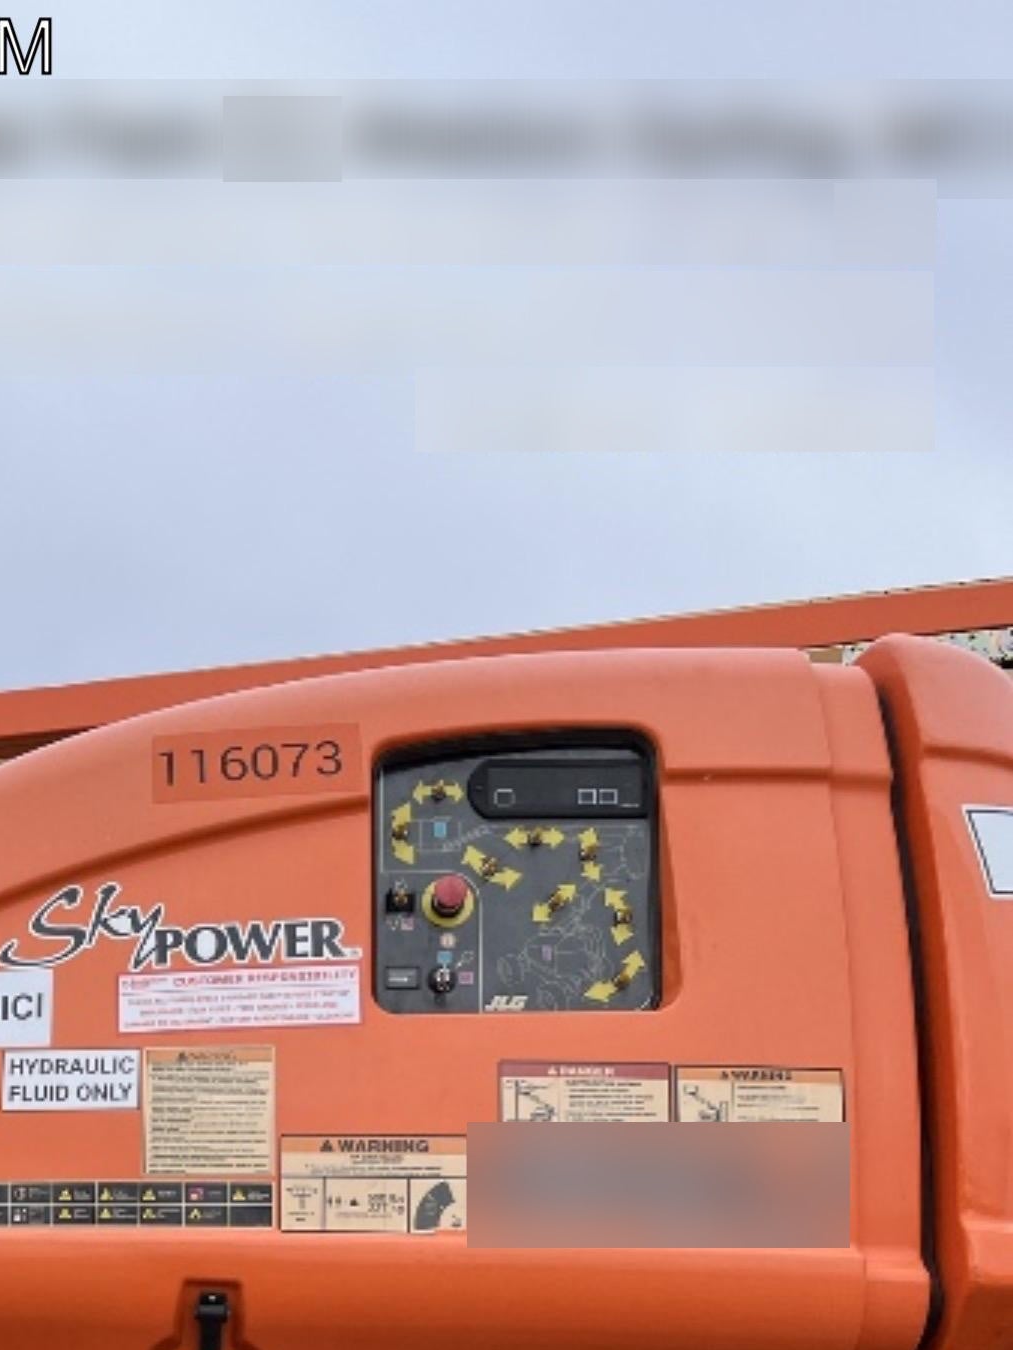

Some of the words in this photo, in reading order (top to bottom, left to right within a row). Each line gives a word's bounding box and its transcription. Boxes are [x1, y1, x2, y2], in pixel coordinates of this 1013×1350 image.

[158, 739, 343, 787] 116073
[9, 1055, 135, 1076] HYDRAULIC
[8, 1082, 69, 1103] FLUID
[75, 1082, 133, 1102] ONLY
[338, 1138, 431, 1153] WARNING
